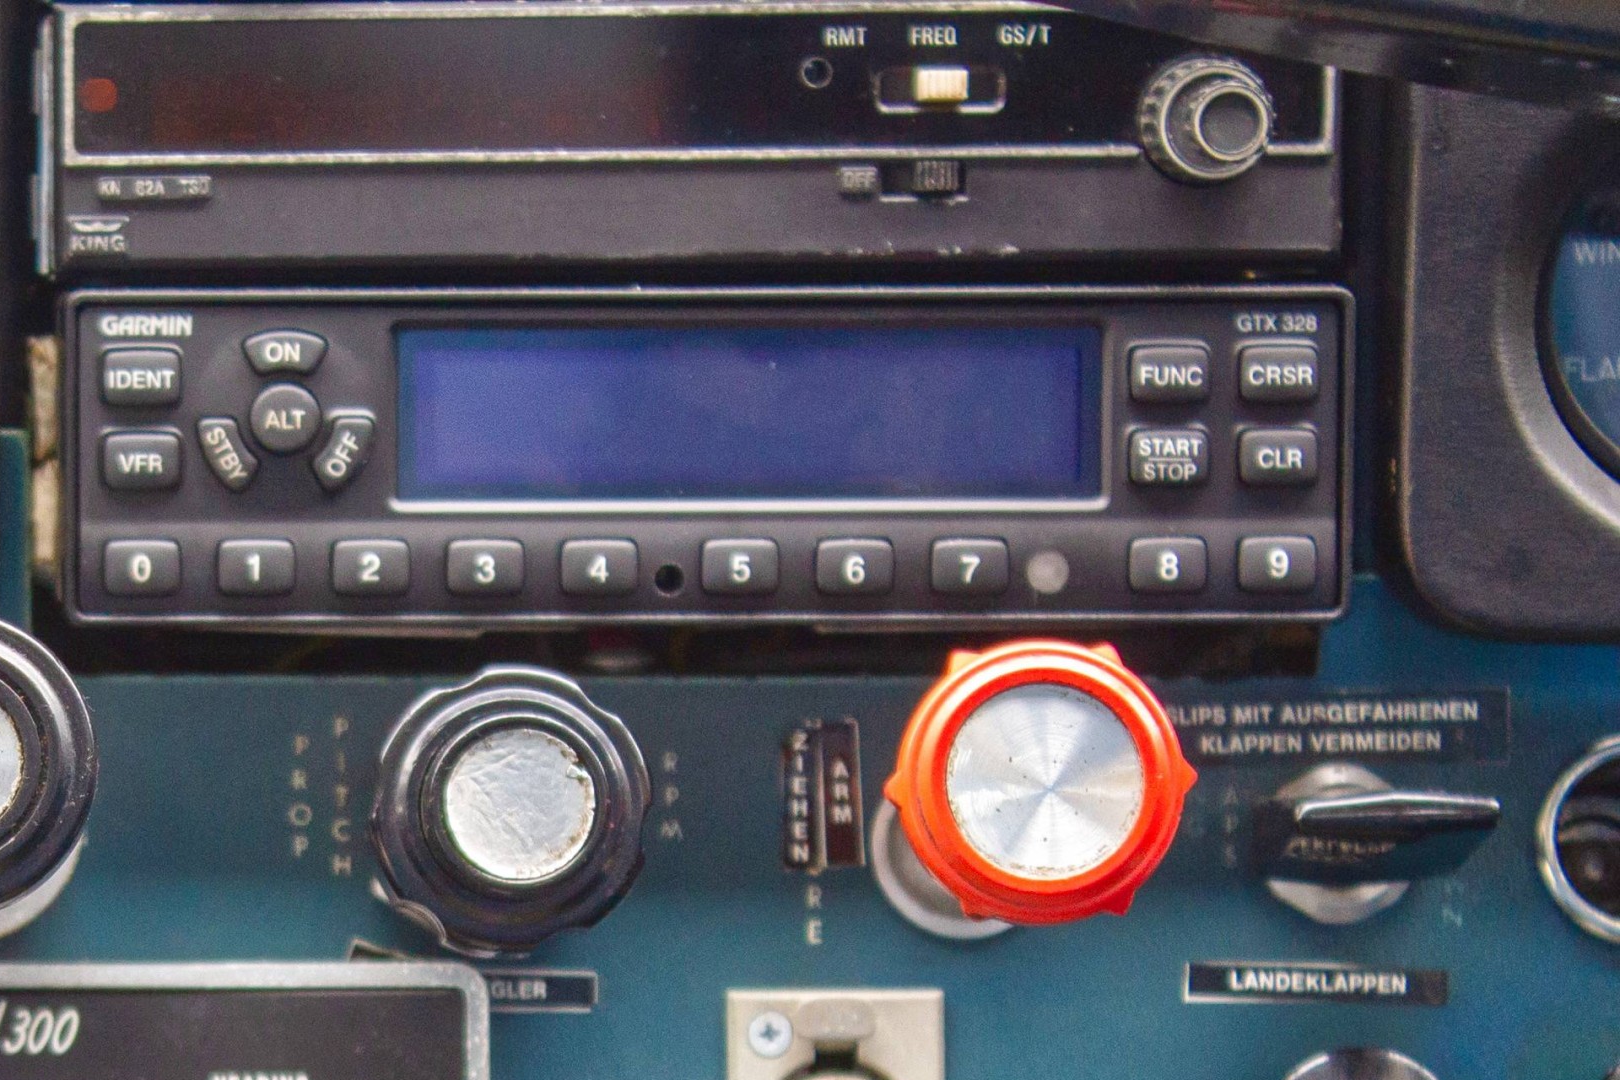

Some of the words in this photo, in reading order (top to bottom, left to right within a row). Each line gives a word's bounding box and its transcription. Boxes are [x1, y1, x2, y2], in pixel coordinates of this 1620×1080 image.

[826, 27, 868, 46] RMT
[910, 27, 957, 47] FREQ
[1000, 25, 1051, 47] GS/T
[100, 180, 122, 196] KN
[70, 234, 126, 252] KING
[100, 315, 192, 337] GARMIN
[1236, 314, 1276, 333] GTX
[1283, 314, 1318, 333] 328
[265, 344, 301, 364] ON
[108, 370, 175, 391] IDENT
[1140, 367, 1203, 388] FUNC
[1248, 366, 1314, 387] CRSR
[265, 411, 305, 432] ALT
[206, 427, 249, 484] STBY
[327, 431, 362, 479] OFF
[1138, 438, 1202, 457] START
[119, 454, 163, 475] VFR
[1258, 448, 1303, 470] CLR
[1143, 462, 1197, 481] STOP
[131, 555, 152, 583] 0
[247, 556, 260, 582] 1
[360, 556, 380, 582] 2
[475, 555, 495, 584] 3
[587, 556, 609, 582] 4
[731, 556, 751, 582] 5
[844, 556, 865, 584] 6
[960, 556, 980, 583] 7
[1158, 553, 1179, 580] 8
[1269, 551, 1289, 578] 9
[1233, 705, 1273, 725] MIT
[1200, 732, 1302, 755] KLAPPEN
[1311, 731, 1442, 753] VERMEIDEN
[1229, 968, 1407, 996] LANDEKLAPPEN
